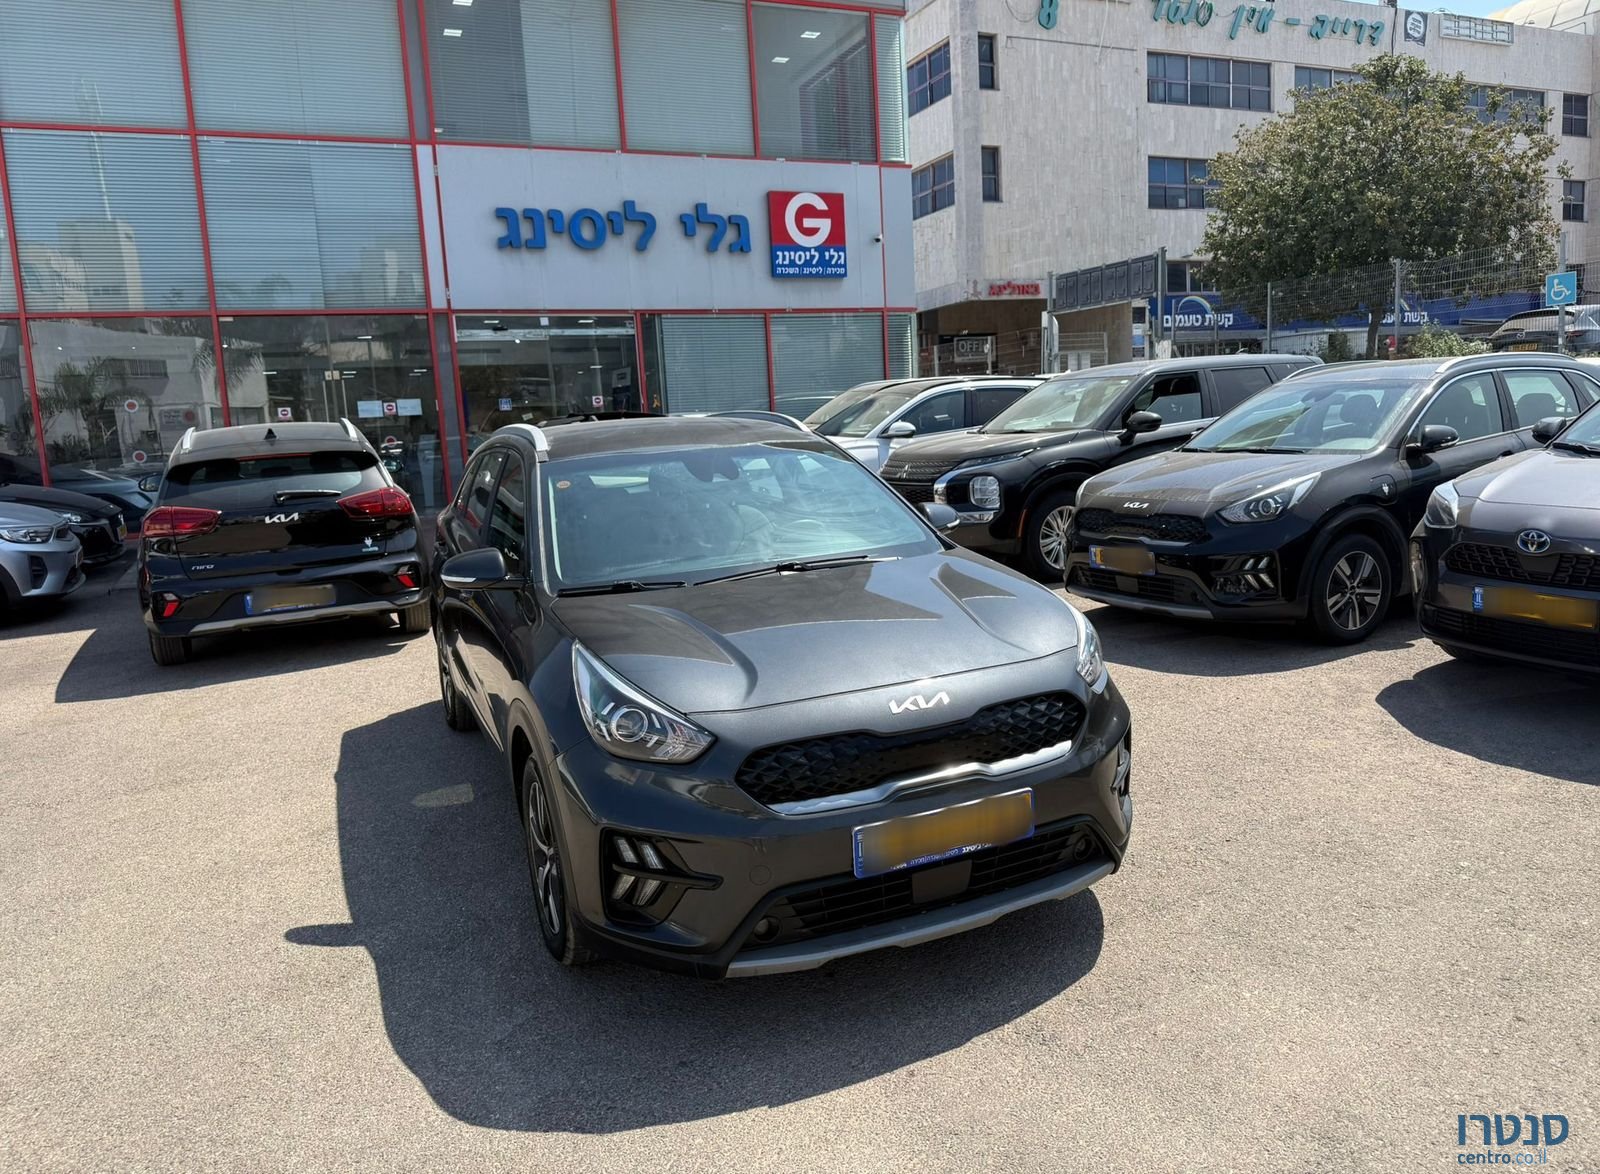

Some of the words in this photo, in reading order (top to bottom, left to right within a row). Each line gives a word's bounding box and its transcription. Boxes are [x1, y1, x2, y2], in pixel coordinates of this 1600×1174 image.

[1229, 4, 1276, 40] אין
[1309, 14, 1385, 46] דרייב
[495, 200, 657, 252] ליסינג
[680, 202, 752, 253] גלי
[784, 191, 832, 248] G
[775, 248, 820, 265] ליסינג
[824, 248, 845, 265] גלי
[776, 266, 800, 275] השכרה
[826, 266, 845, 275] מכירה
[264, 512, 299, 524] KIA
[888, 691, 951, 715] KIA
